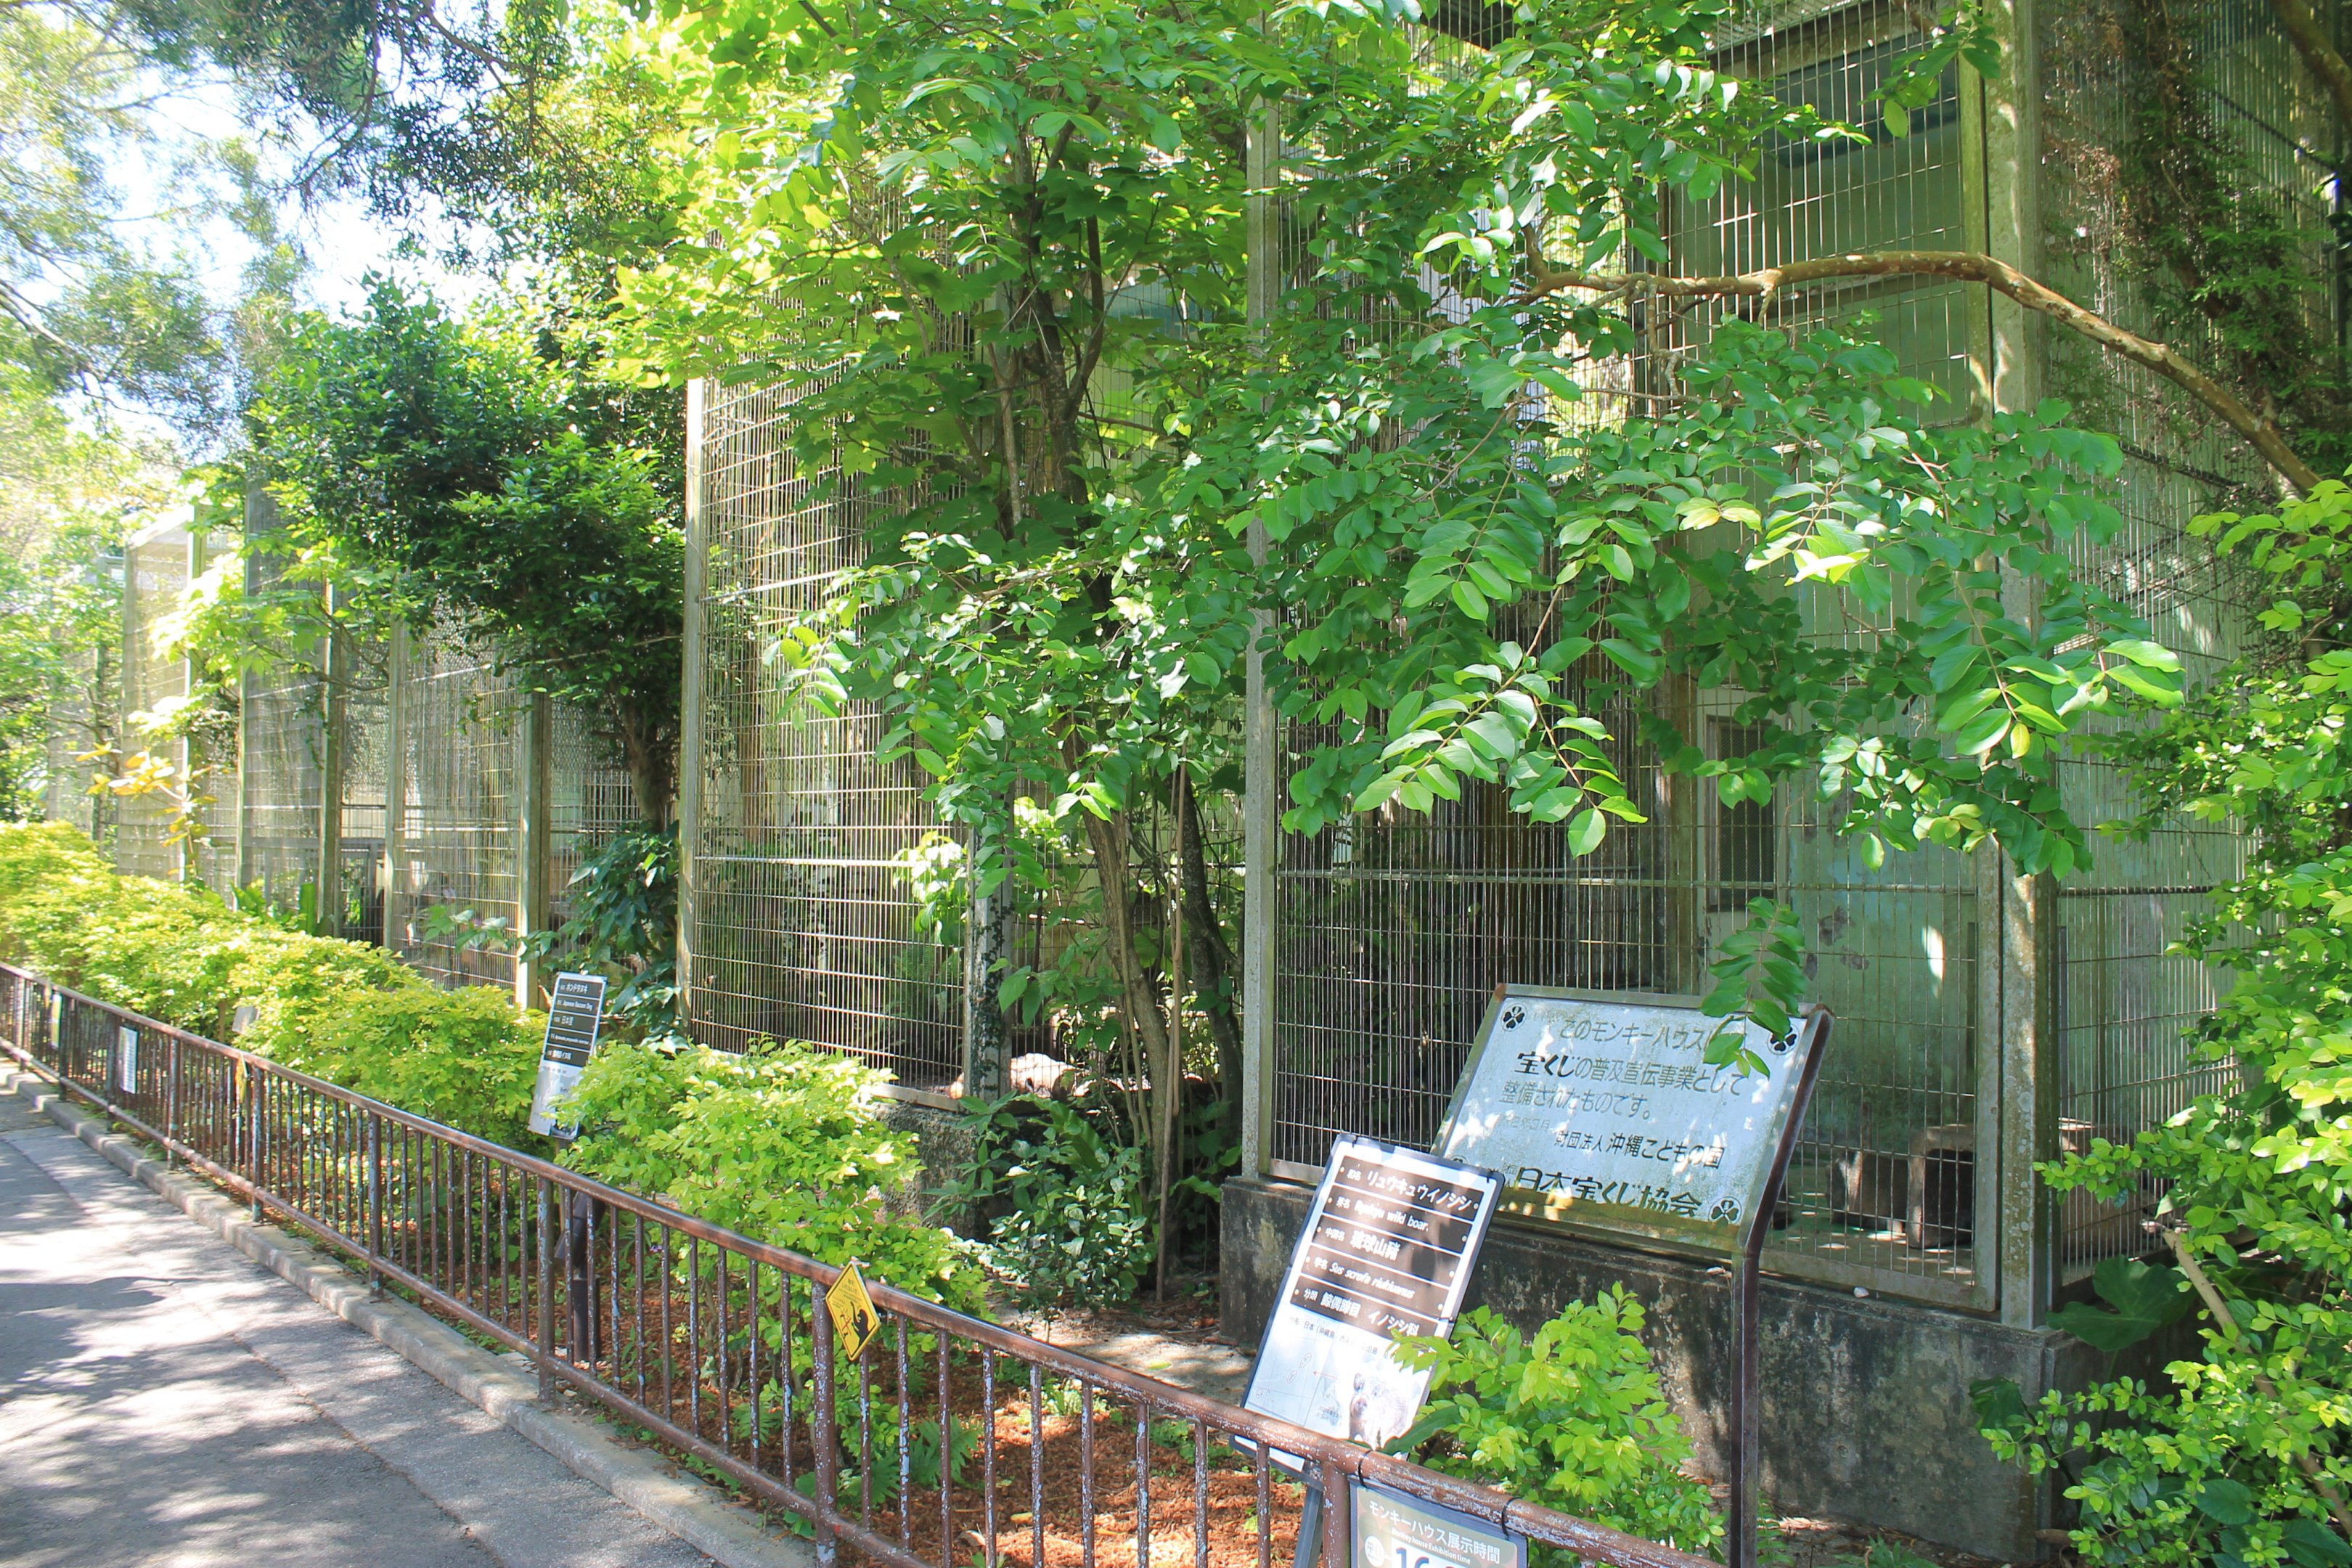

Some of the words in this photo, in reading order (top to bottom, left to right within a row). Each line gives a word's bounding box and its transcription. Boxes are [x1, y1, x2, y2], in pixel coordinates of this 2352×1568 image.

[1514, 1051, 1747, 1095] 宝くじの普及宣伝事業として
[1498, 1080, 1650, 1120] 整備されたものです。
[1554, 1130, 1603, 1153] 財団法人
[1606, 1132, 1725, 1169] 沖縄こどもの国
[1367, 1169, 1472, 1212] リュウキュウイノシシ
[1516, 1167, 1703, 1217] 日本宝くじ協会
[1387, 1211, 1407, 1225] wild
[1329, 1262, 1345, 1275] Sus
[1344, 1270, 1371, 1284] scrofa
[1303, 1288, 1319, 1302] 分類
[1368, 1310, 1420, 1336] イノシシ科
[1369, 1500, 1501, 1564] モンキーハウス展示時間
[1412, 1536, 1429, 1549] house
[1429, 1542, 1457, 1559] Exhibition
[1456, 1553, 1471, 1565] time
